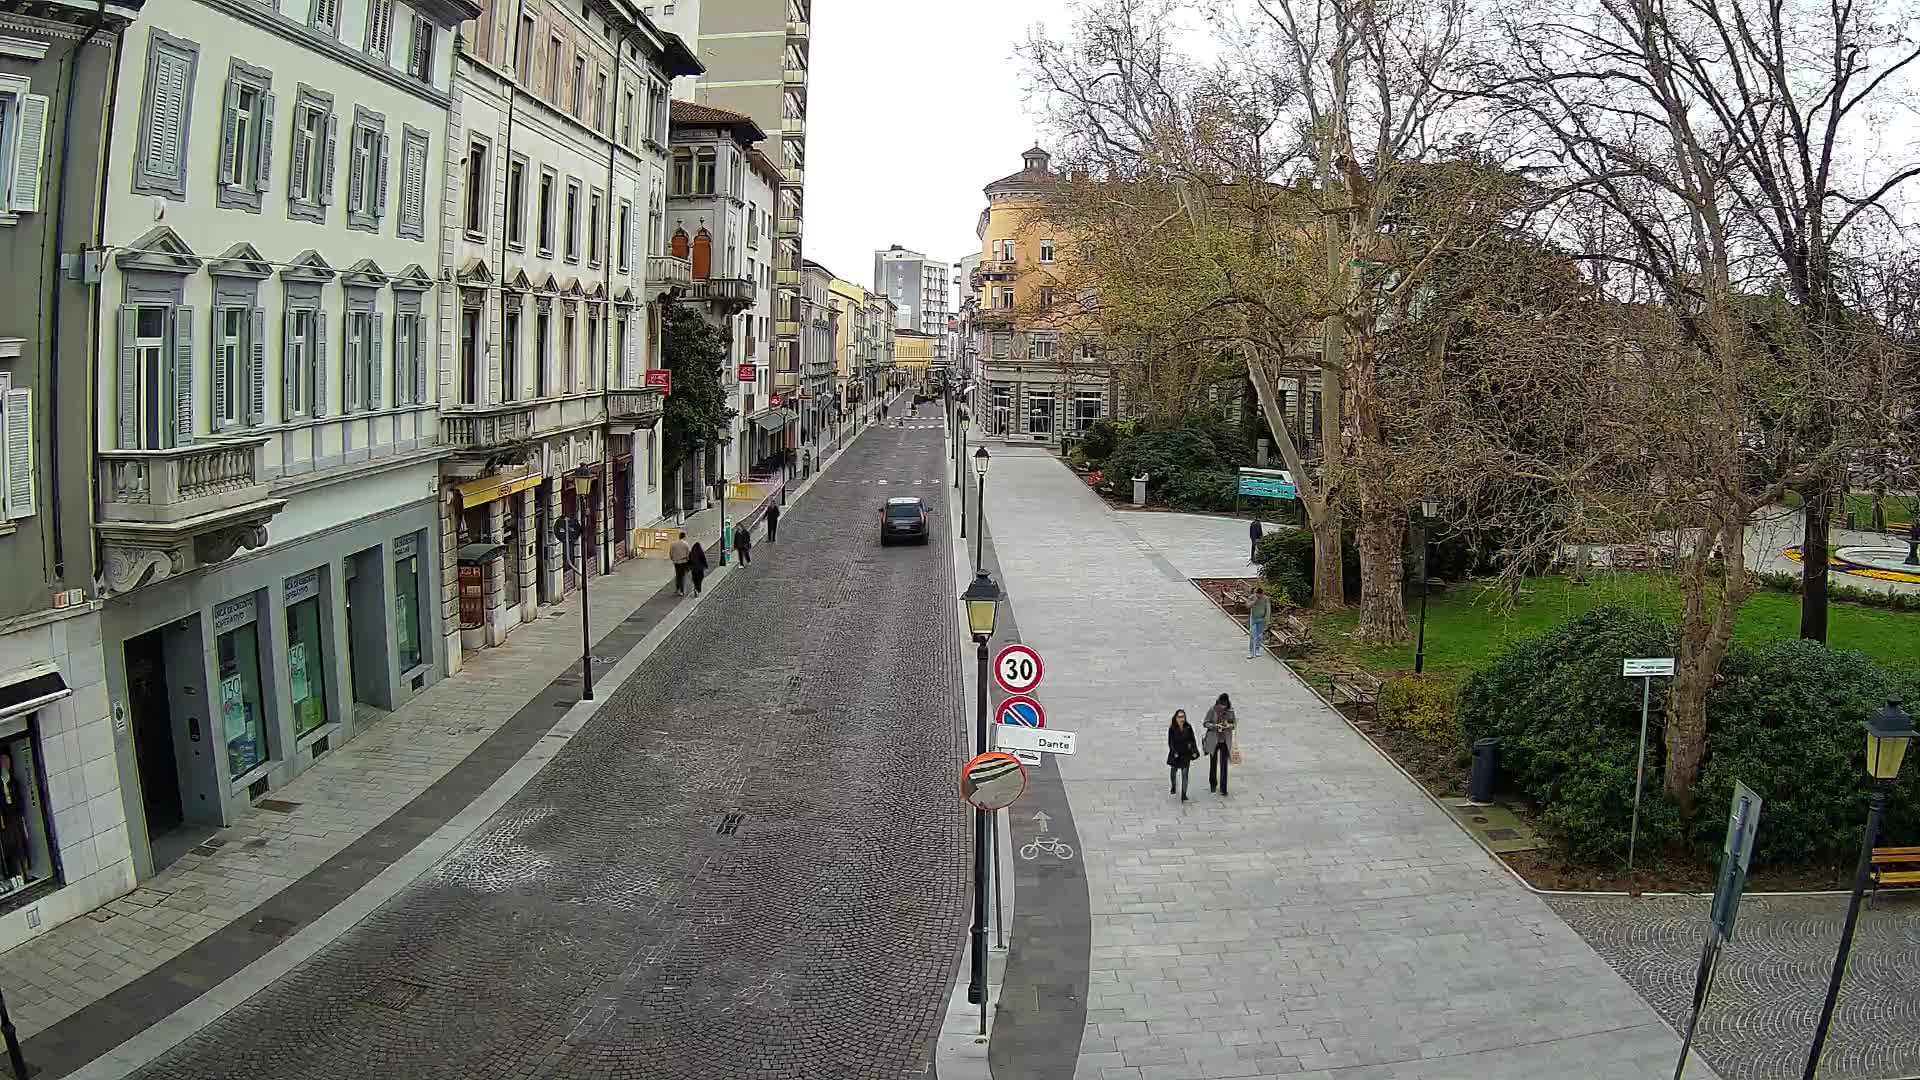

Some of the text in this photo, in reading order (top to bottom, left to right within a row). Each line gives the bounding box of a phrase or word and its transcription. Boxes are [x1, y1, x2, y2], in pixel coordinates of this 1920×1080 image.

[1006, 658, 1033, 681] 30
[223, 678, 240, 701] 130
[1038, 738, 1070, 750] Dante
